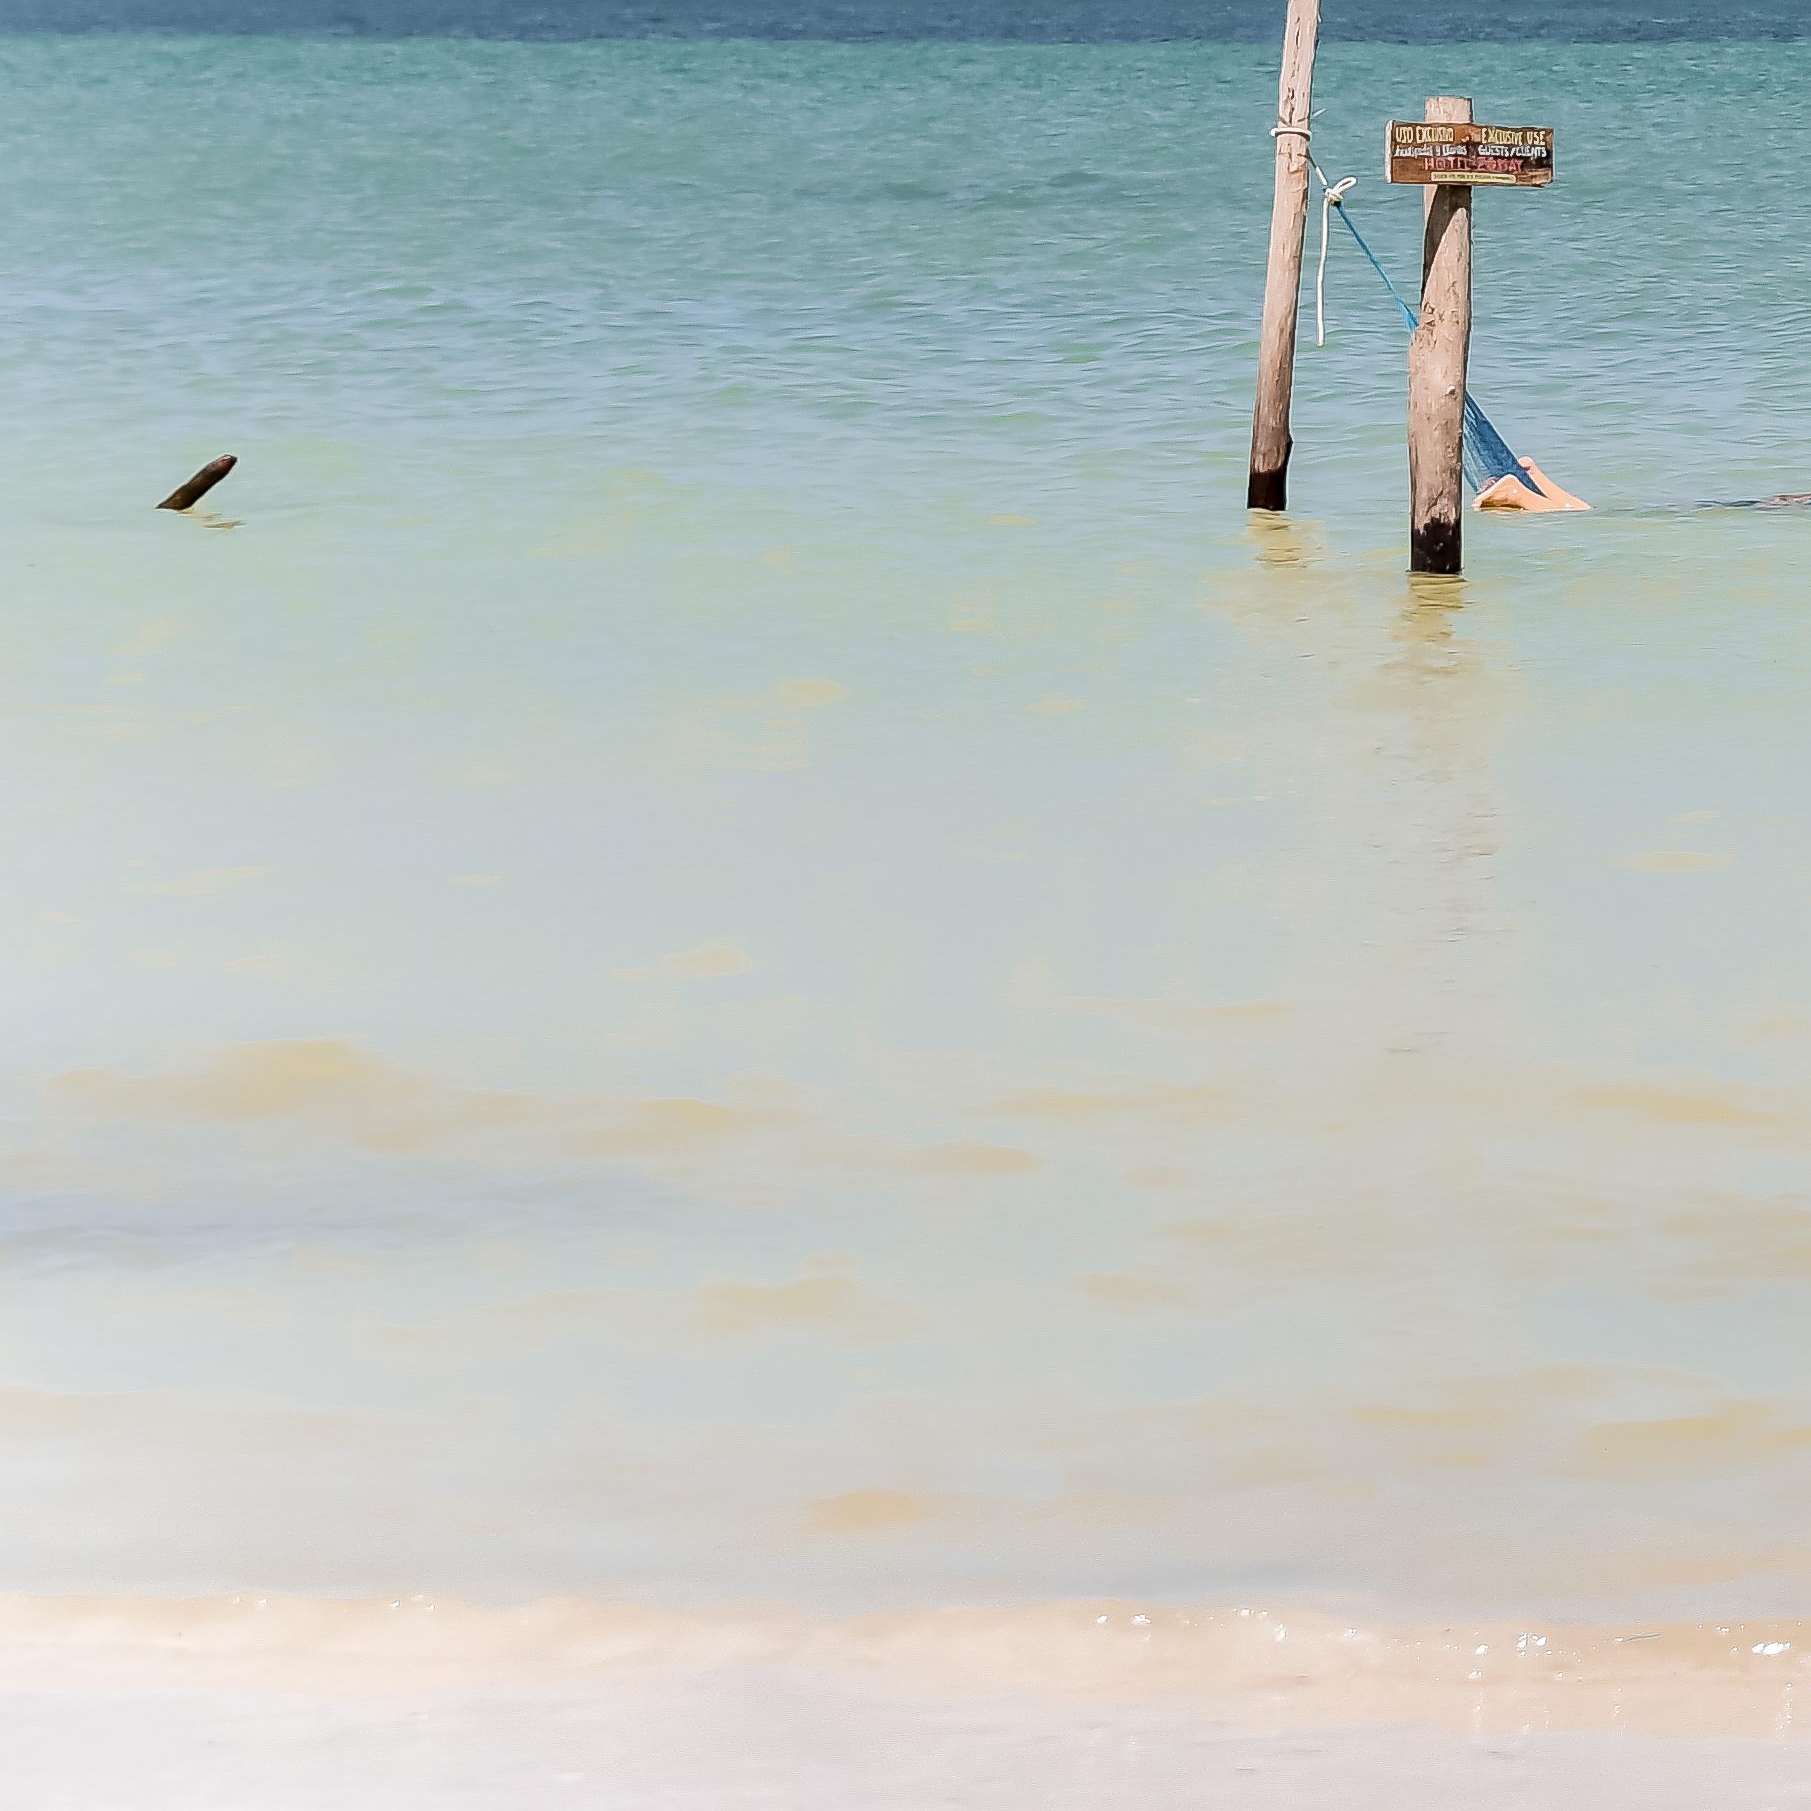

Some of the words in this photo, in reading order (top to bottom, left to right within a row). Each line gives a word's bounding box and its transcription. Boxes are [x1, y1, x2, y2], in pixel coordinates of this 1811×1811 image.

[1395, 126, 1414, 144] USO
[1481, 127, 1523, 146] EXCLUSIVE
[1526, 130, 1546, 146] USE
